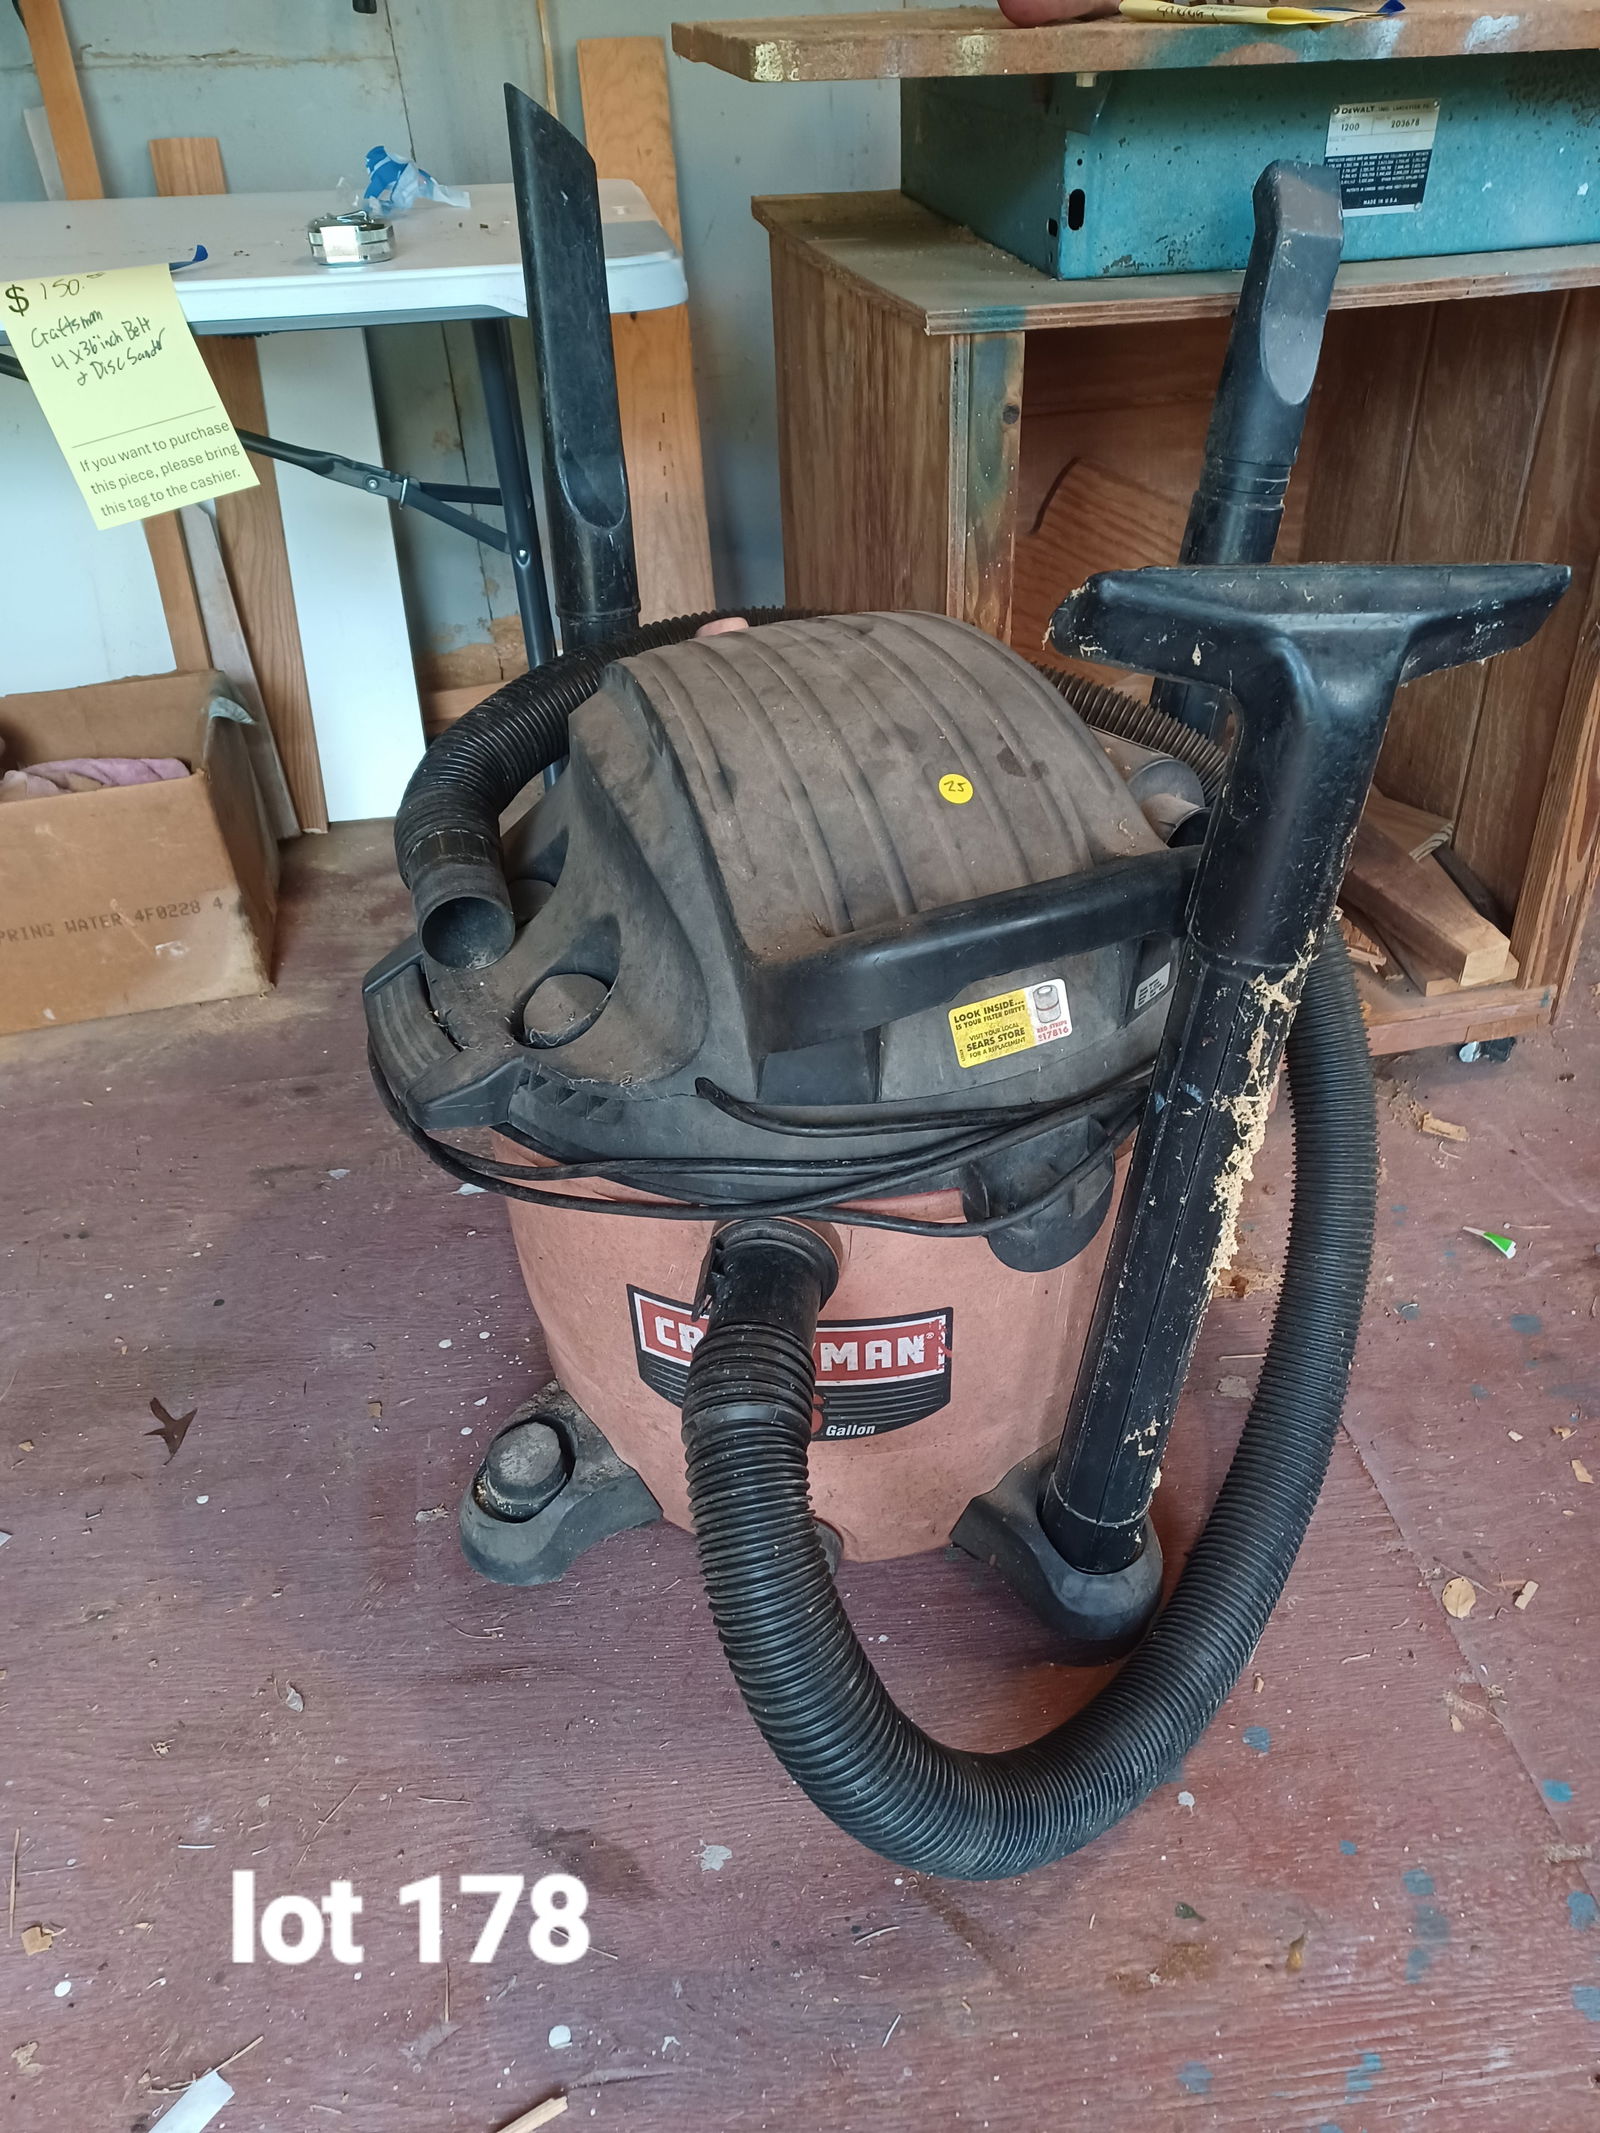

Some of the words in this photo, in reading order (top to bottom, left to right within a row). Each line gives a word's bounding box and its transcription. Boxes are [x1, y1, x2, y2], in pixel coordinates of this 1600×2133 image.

[1341, 123, 1360, 131] 1200
[1391, 118, 1420, 128] 203678
[5, 284, 30, 317] $
[31, 310, 103, 349] Craftsman
[51, 354, 70, 370] 4
[121, 316, 151, 341] Belt
[89, 357, 126, 379] Disc
[127, 327, 166, 365] Sander
[80, 460, 91, 472] If
[91, 454, 117, 472] you
[117, 443, 152, 462] want
[152, 439, 167, 452] to
[169, 421, 230, 449] purchase
[90, 480, 117, 495] this
[118, 469, 159, 489] piece,
[160, 453, 204, 477] please
[205, 443, 240, 462] bring
[100, 501, 127, 517] this
[127, 494, 151, 508] tag
[150, 490, 165, 502] to
[166, 484, 189, 497] the
[191, 468, 241, 491] cashier.
[944, 780, 966, 792] 25
[65, 911, 122, 935] WATER
[212, 896, 223, 910] 4
[954, 1009, 980, 1023] LOOK
[984, 999, 1024, 1014] INSIDE...
[964, 1018, 981, 1028] YOUR
[983, 1012, 1002, 1022] FILTER
[1004, 1004, 1025, 1016] DIRTY?
[966, 1037, 995, 1051] SEARS
[997, 1027, 1025, 1042] STORE
[969, 1032, 983, 1041] VISIT
[984, 1027, 1001, 1037] YOUR
[1002, 1022, 1019, 1031] LOCAL
[969, 1050, 981, 1058] FOR
[988, 1037, 1026, 1053] REPLACEMENT
[826, 1424, 876, 1436] Gallon
